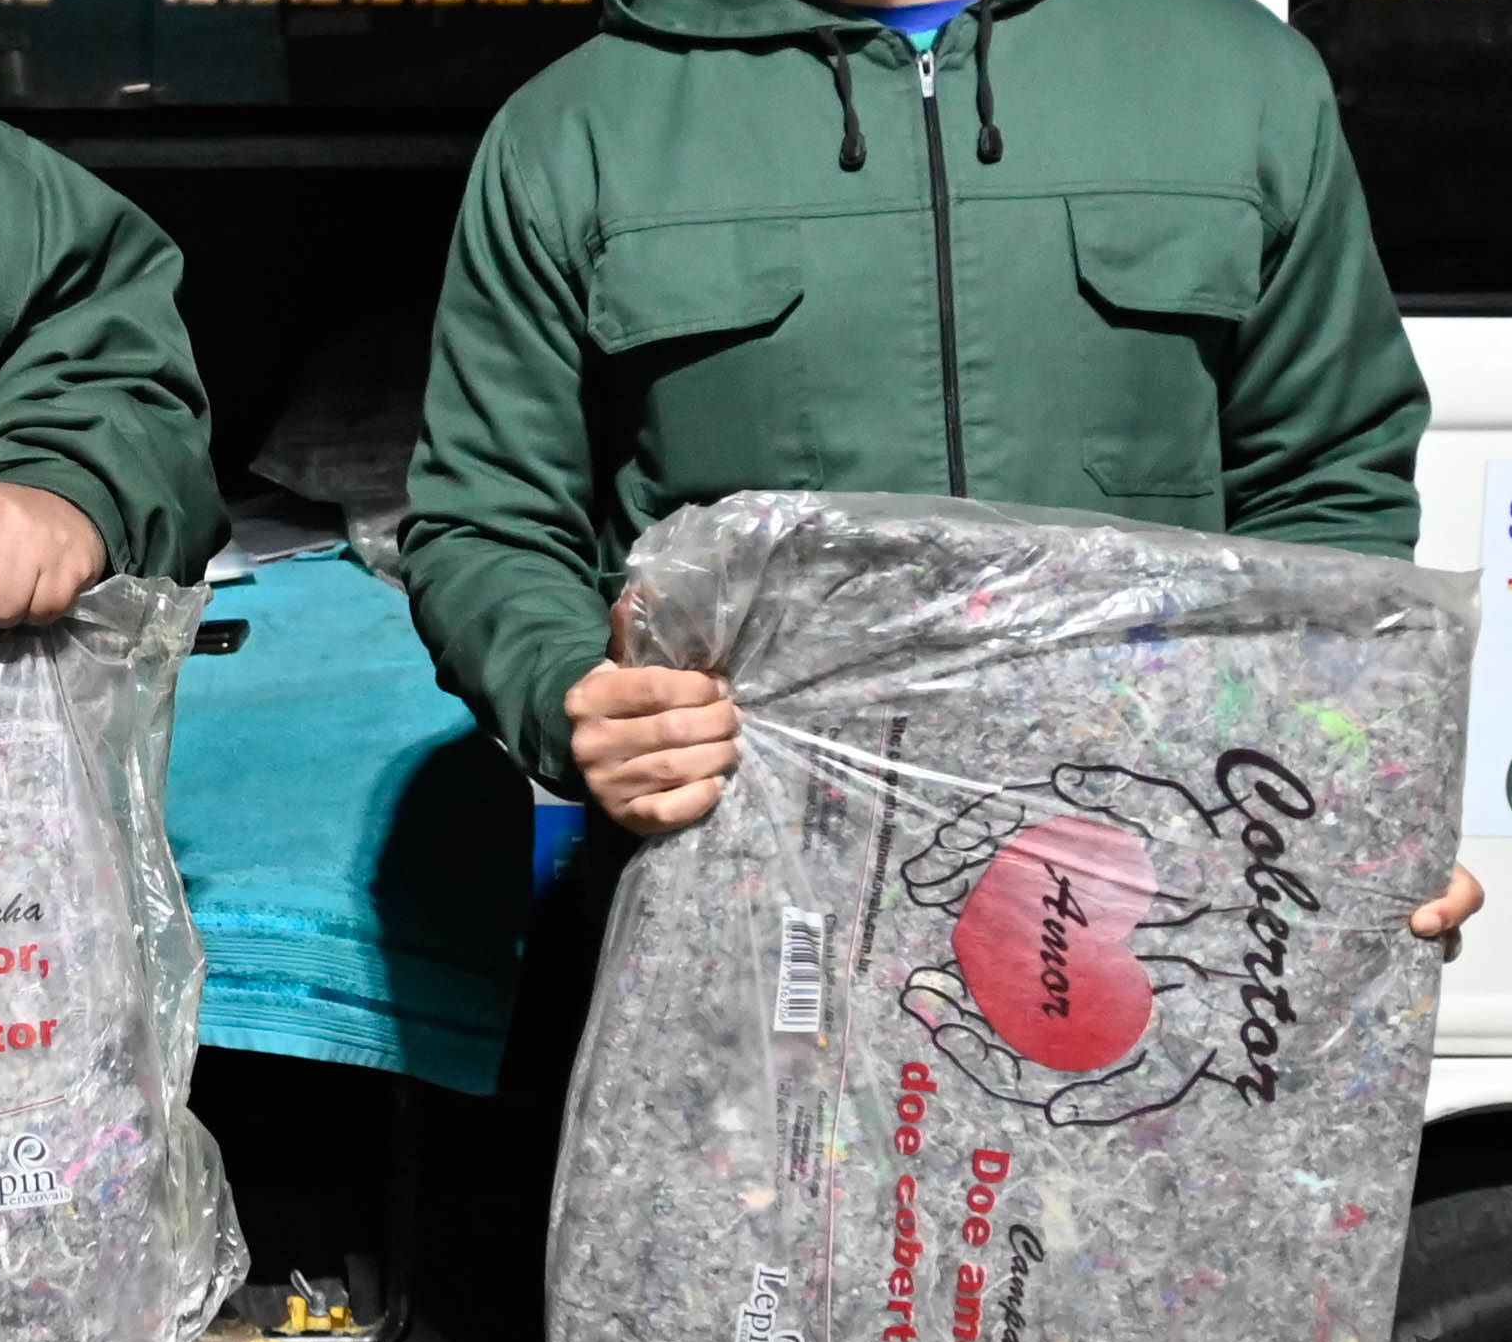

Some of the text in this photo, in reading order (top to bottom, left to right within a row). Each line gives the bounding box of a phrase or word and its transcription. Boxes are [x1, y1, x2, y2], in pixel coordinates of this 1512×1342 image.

[1040, 862, 1089, 1019] Amor
[1216, 748, 1321, 1107] Cobertor
[895, 1061, 939, 1155] doe
[8, 1189, 71, 1205] enxovais
[962, 1148, 1012, 1247] Doe
